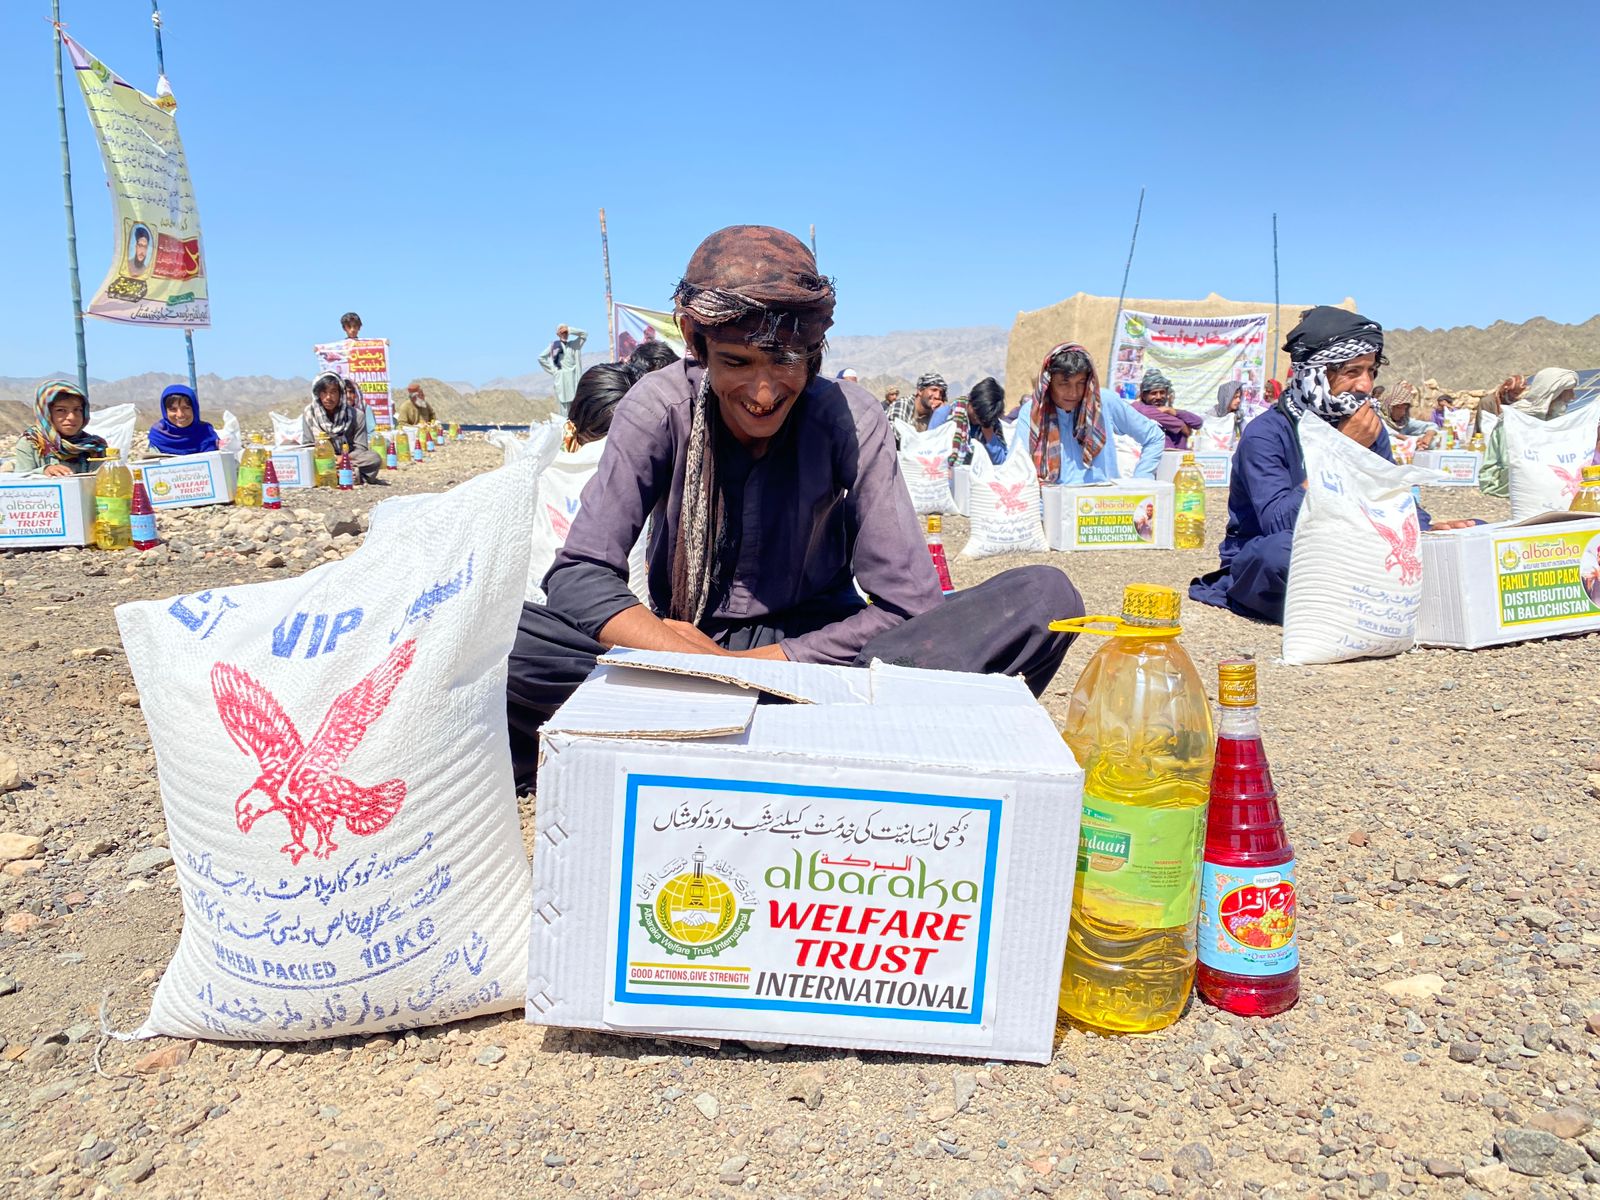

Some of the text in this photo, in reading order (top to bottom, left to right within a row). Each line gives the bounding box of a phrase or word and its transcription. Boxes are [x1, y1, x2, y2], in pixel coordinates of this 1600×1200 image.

[1556, 453, 1577, 464] VIP
[174, 480, 208, 488] WELFARE
[9, 511, 58, 519] WELFARE
[17, 519, 52, 527] TRUST
[1080, 515, 1132, 524] FAMILY FOOD PACK
[9, 527, 61, 535] INTERNATIONAL
[1081, 526, 1132, 534] DISTRIBUTION
[1088, 534, 1137, 542] BALOCHISTAN
[1522, 541, 1580, 559] albaraka
[1501, 567, 1579, 590] FAMILY FOOD PACK
[1504, 585, 1580, 606] DISTRIBUTION
[1504, 600, 1590, 621] IN BALOCHISTAN
[271, 607, 364, 659] VIP
[854, 809, 882, 844] کی
[764, 848, 978, 908] albaraka
[1255, 875, 1280, 884] Hamdard
[769, 900, 972, 941] WELFARE
[643, 907, 749, 955] Albaraka Welfare Trust International
[212, 940, 258, 976] WHEN
[263, 959, 337, 981] PACKED
[794, 938, 939, 976] TRUST
[631, 968, 653, 979] GOOD
[709, 972, 749, 983] STRENGTH
[755, 971, 969, 1010] INTERNATIONAL
